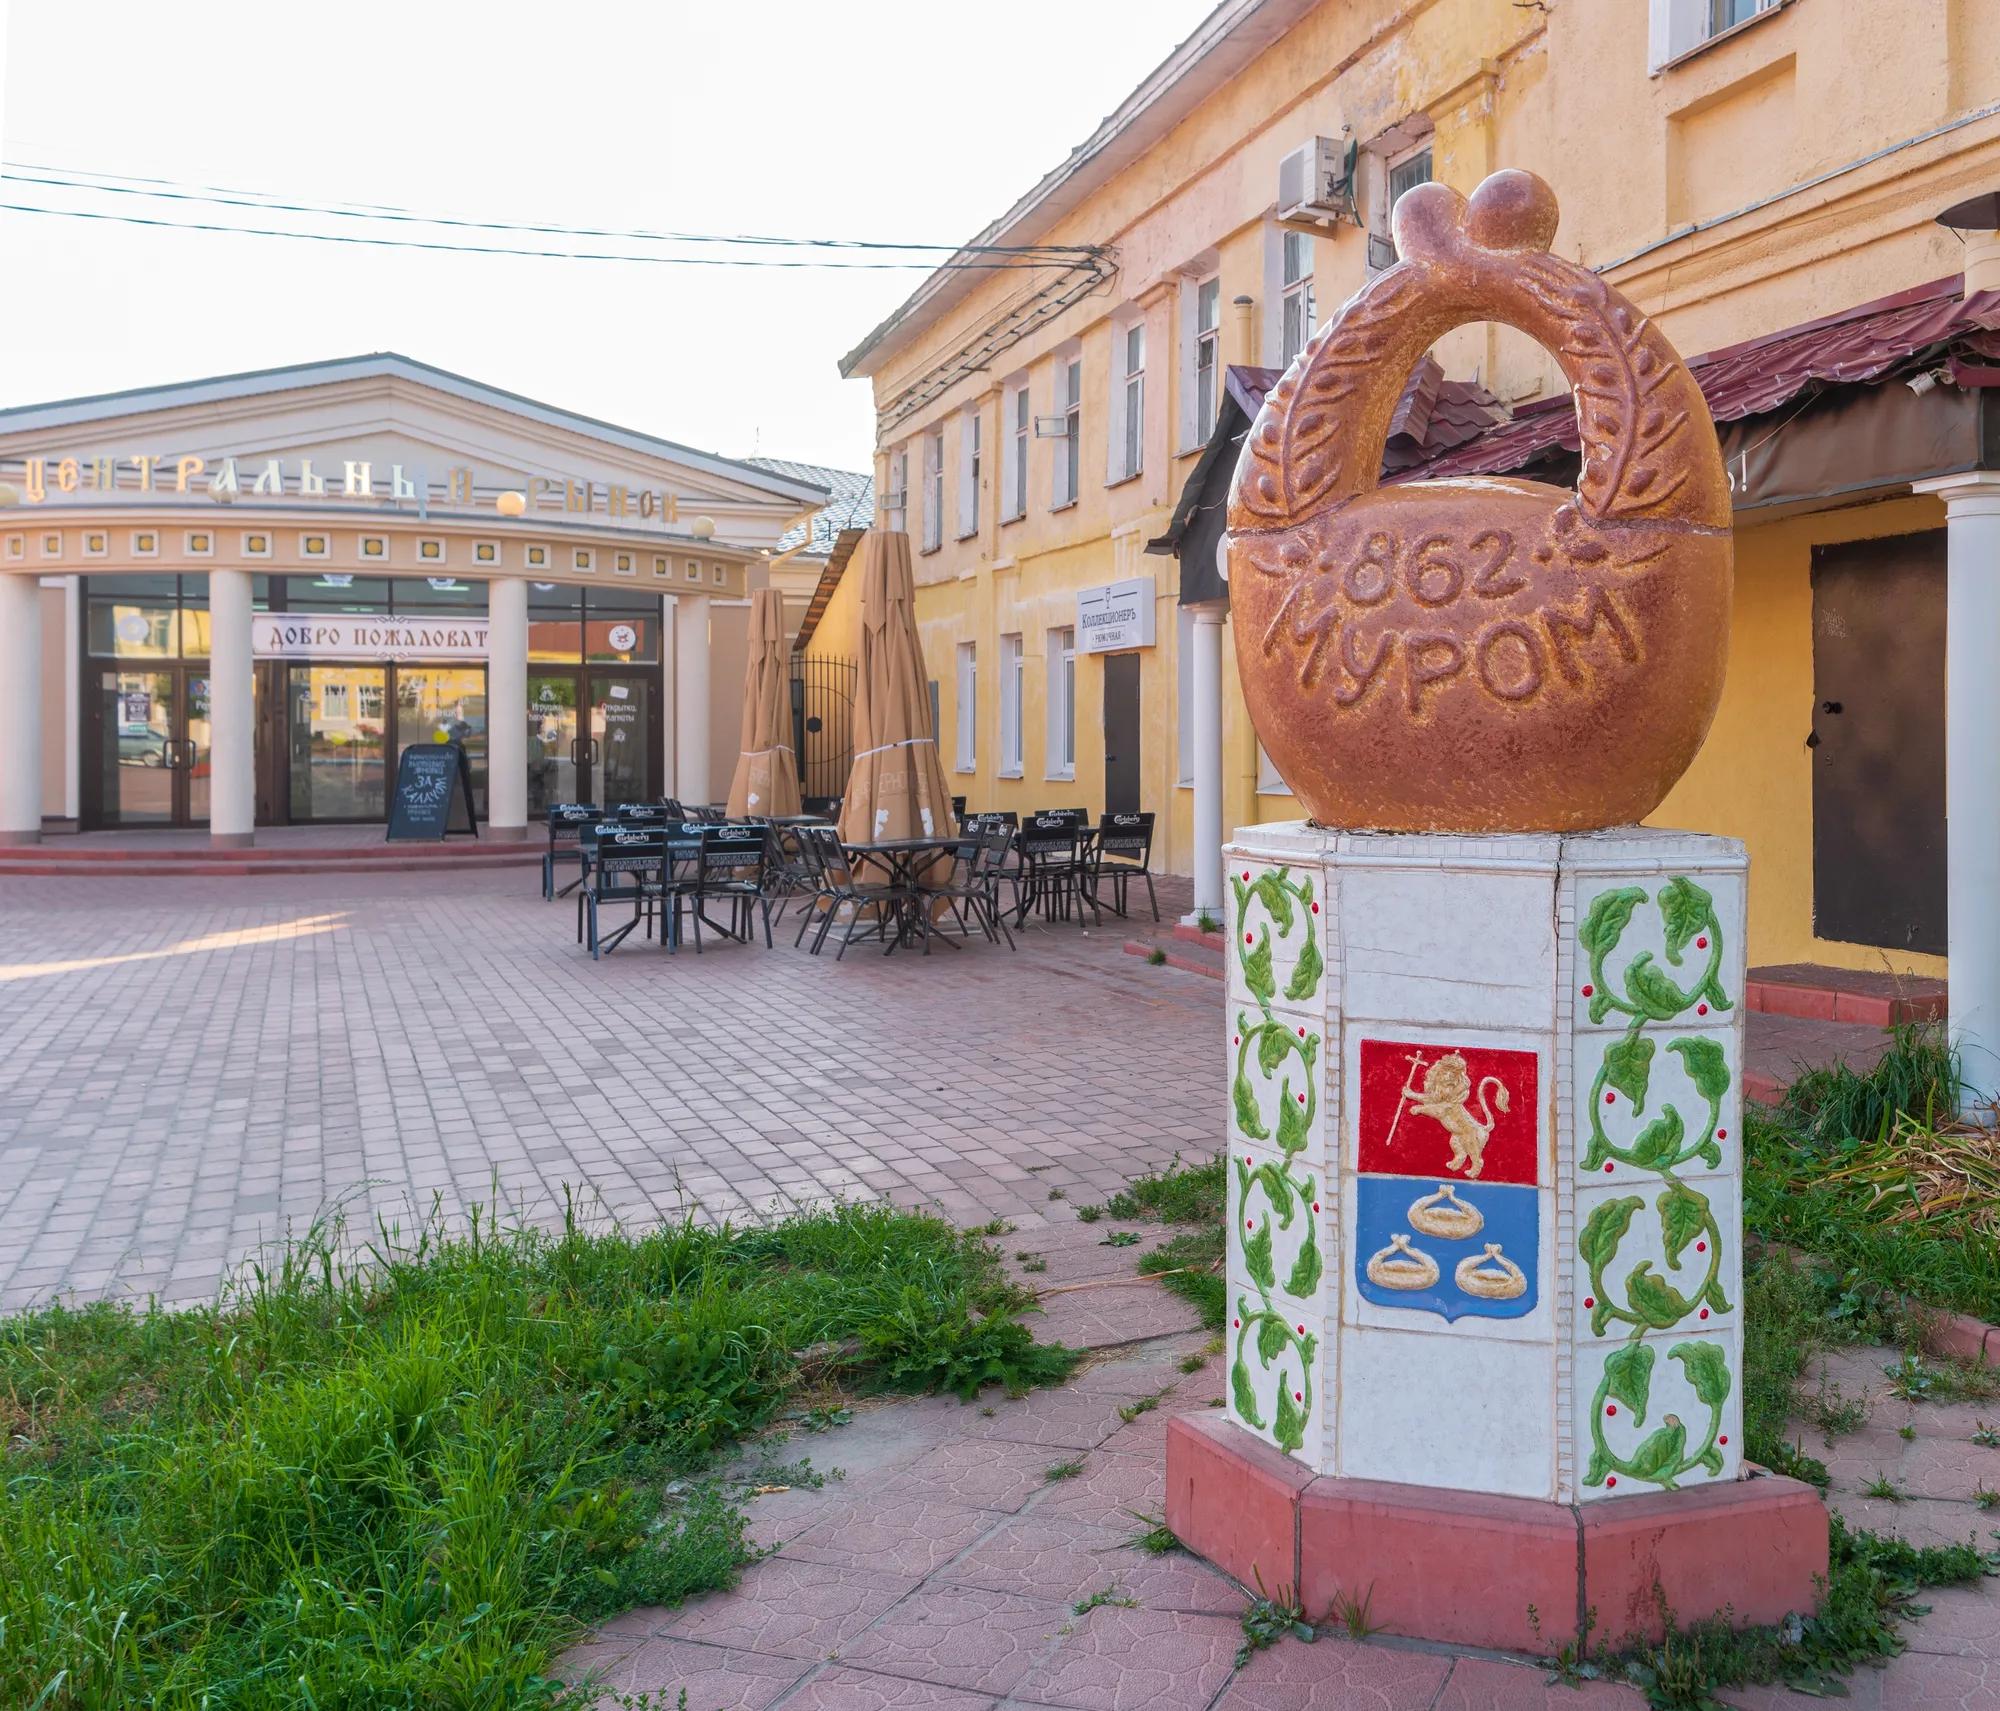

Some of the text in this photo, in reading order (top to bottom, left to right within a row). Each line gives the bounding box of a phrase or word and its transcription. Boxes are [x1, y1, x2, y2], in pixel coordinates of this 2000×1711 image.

[526, 476, 679, 524] РЫНОК
[1342, 528, 1533, 608] 862
[270, 627, 488, 650] ДОБРО ПОЖАЛОВАТ
[1262, 583, 1646, 716] МУРОМ
[1036, 818, 1064, 828] Carlsberg
[1114, 815, 1140, 824] Carlsberg
[615, 833, 649, 844] Carlsberg
[719, 829, 750, 839] Carlsberg
